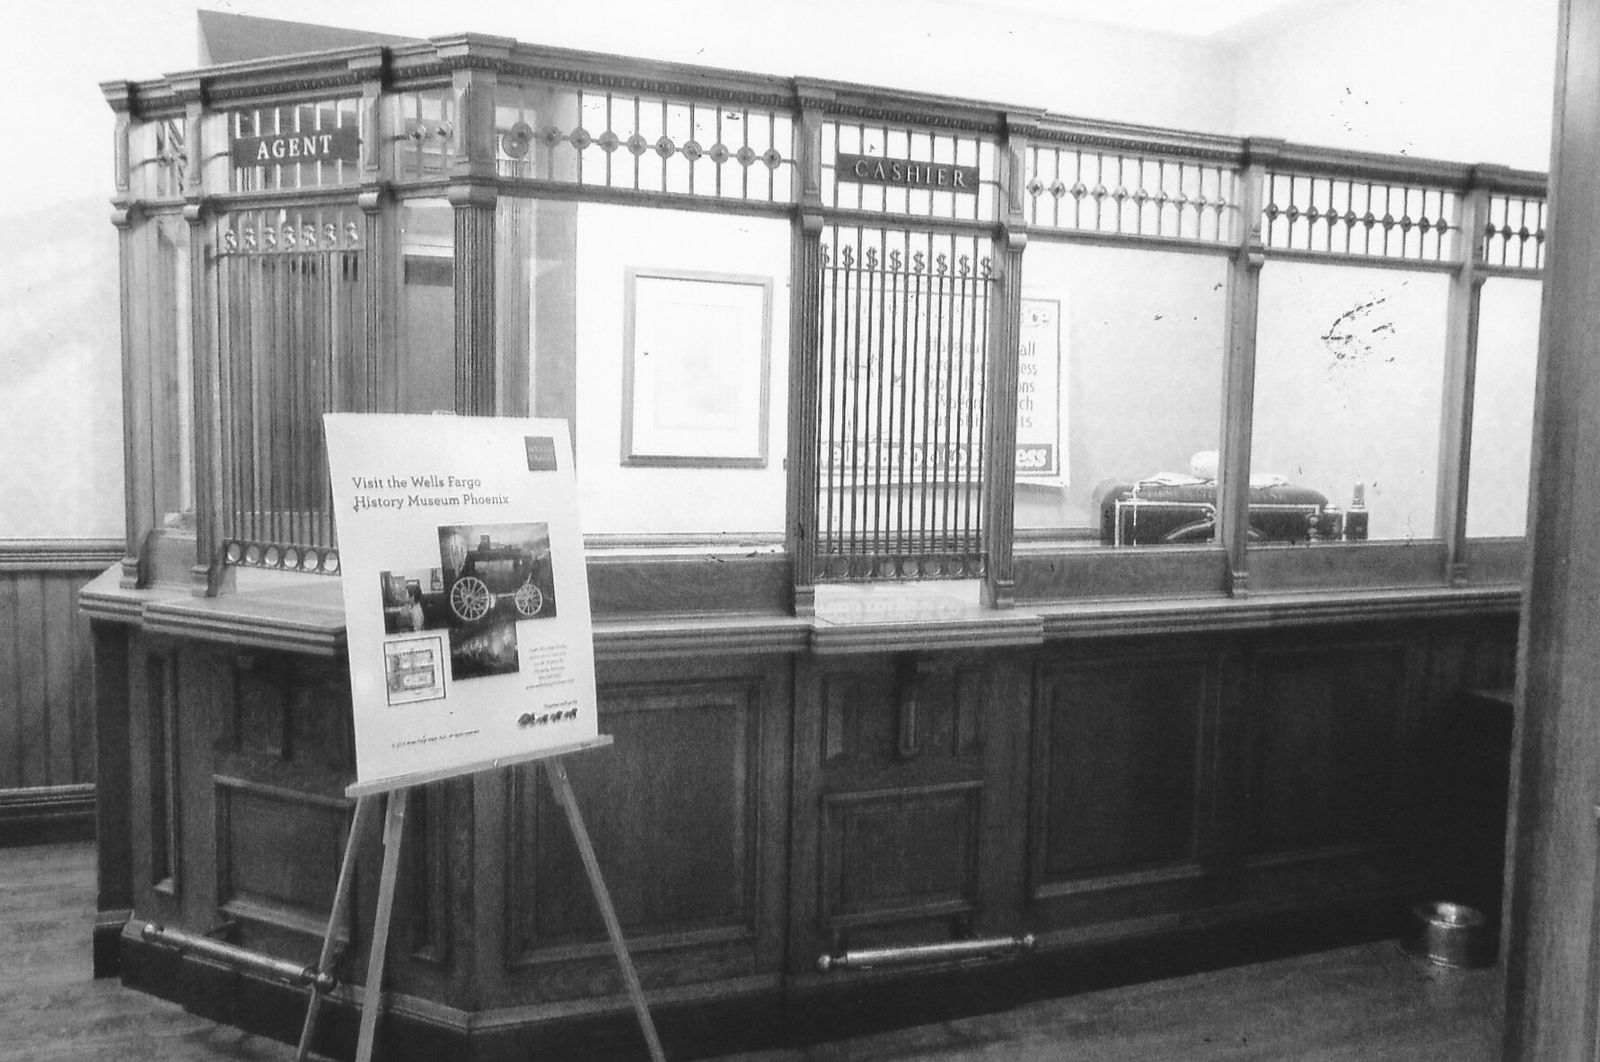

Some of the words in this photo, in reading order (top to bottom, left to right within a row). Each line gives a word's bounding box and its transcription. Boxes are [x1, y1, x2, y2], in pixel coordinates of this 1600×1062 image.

[257, 134, 332, 160] AGENT
[855, 159, 966, 188] CASHIER
[352, 476, 384, 489] Visit
[387, 475, 408, 488] the
[410, 474, 445, 488] Wells
[448, 475, 482, 490] Fargo
[354, 495, 404, 510] History
[408, 494, 460, 507] Museum
[463, 493, 510, 506] Phoenix
